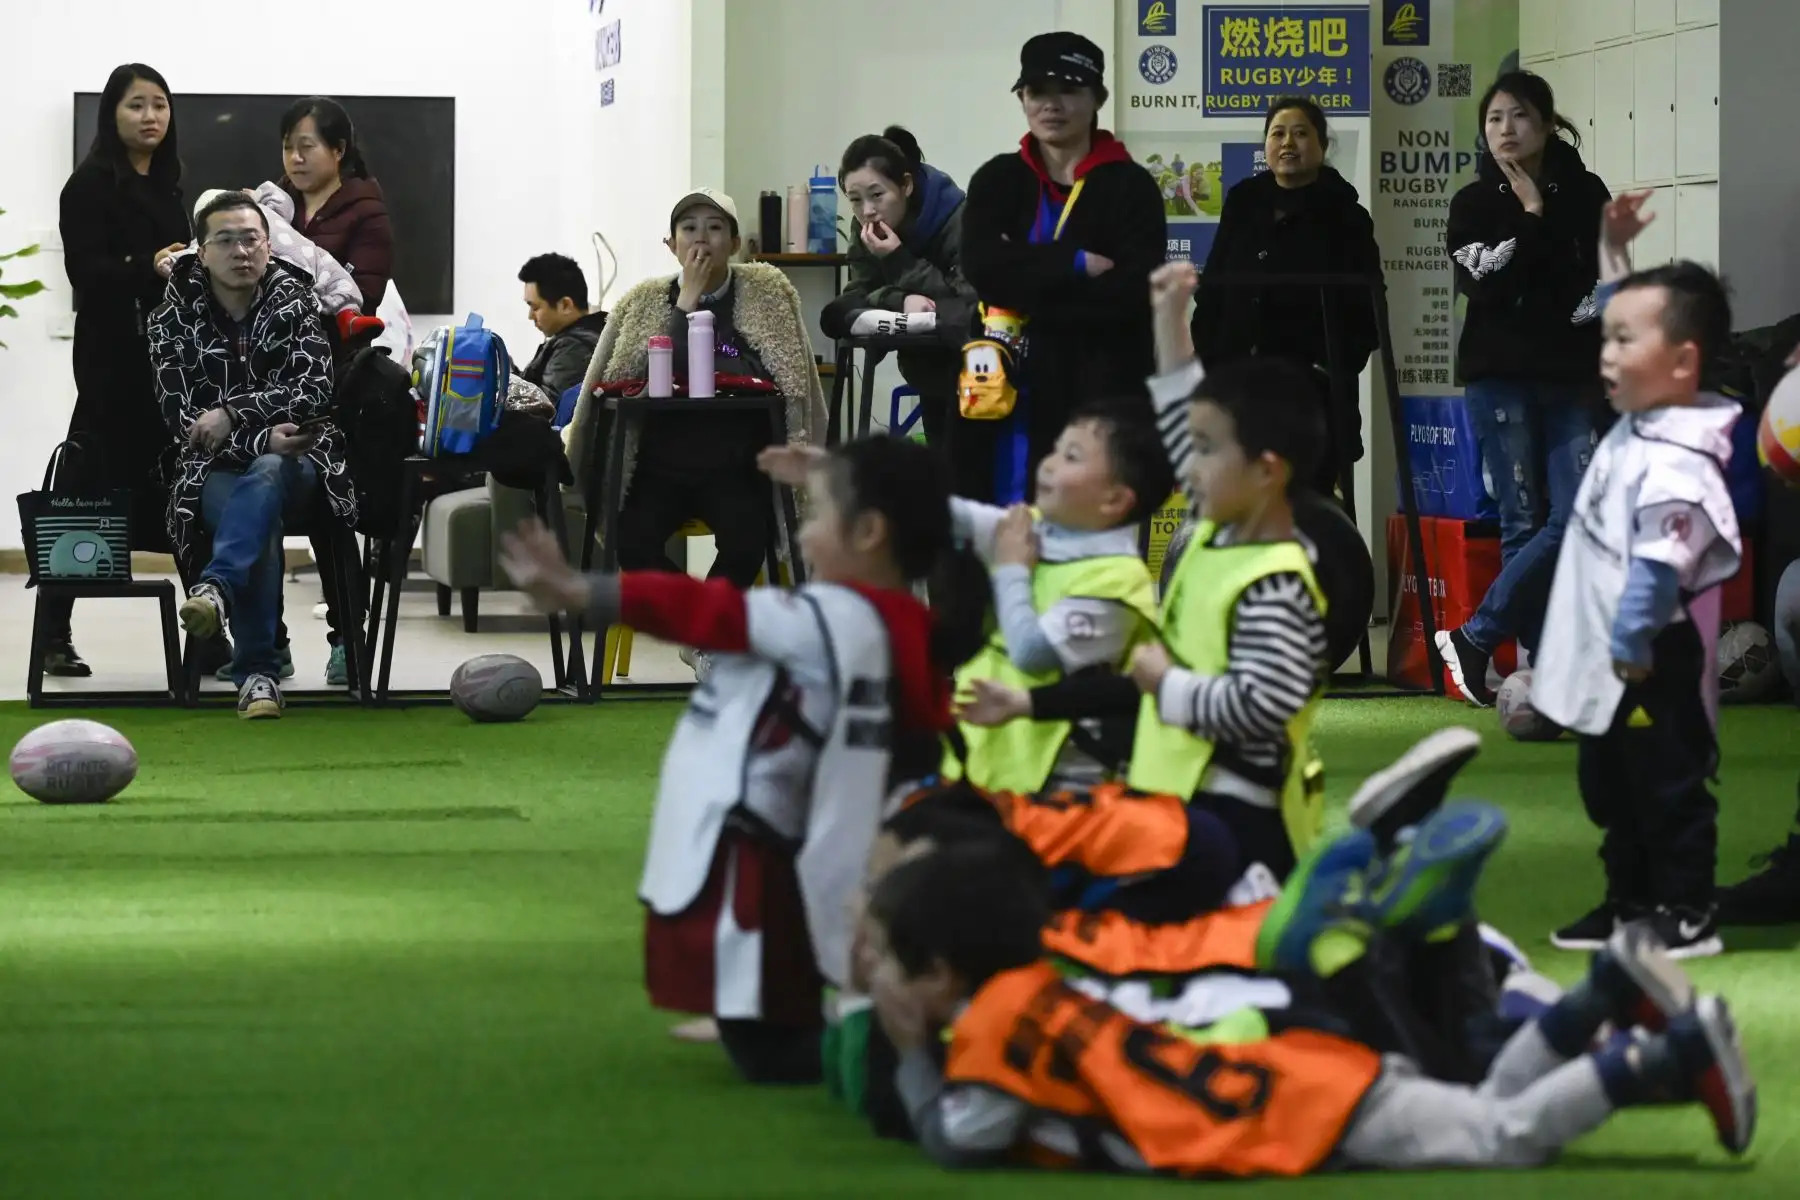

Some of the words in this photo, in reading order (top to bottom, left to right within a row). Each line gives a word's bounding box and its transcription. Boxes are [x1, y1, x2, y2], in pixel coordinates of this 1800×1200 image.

[1220, 16, 1349, 57] 燃烧吧
[1130, 95, 1175, 108] BURN
[1181, 95, 1200, 110] IT,
[1205, 95, 1261, 108] RUGBY
[1265, 94, 1352, 108] TAGER
[1398, 130, 1449, 147] NON
[1379, 178, 1448, 193] RUGBY
[1393, 199, 1449, 208] RANGERS
[1414, 218, 1449, 228] BURN
[1407, 246, 1447, 256] RUGBY
[1384, 260, 1449, 270] TEENAGER
[1398, 368, 1449, 384] 练课程
[1153, 521, 1180, 534] TO
